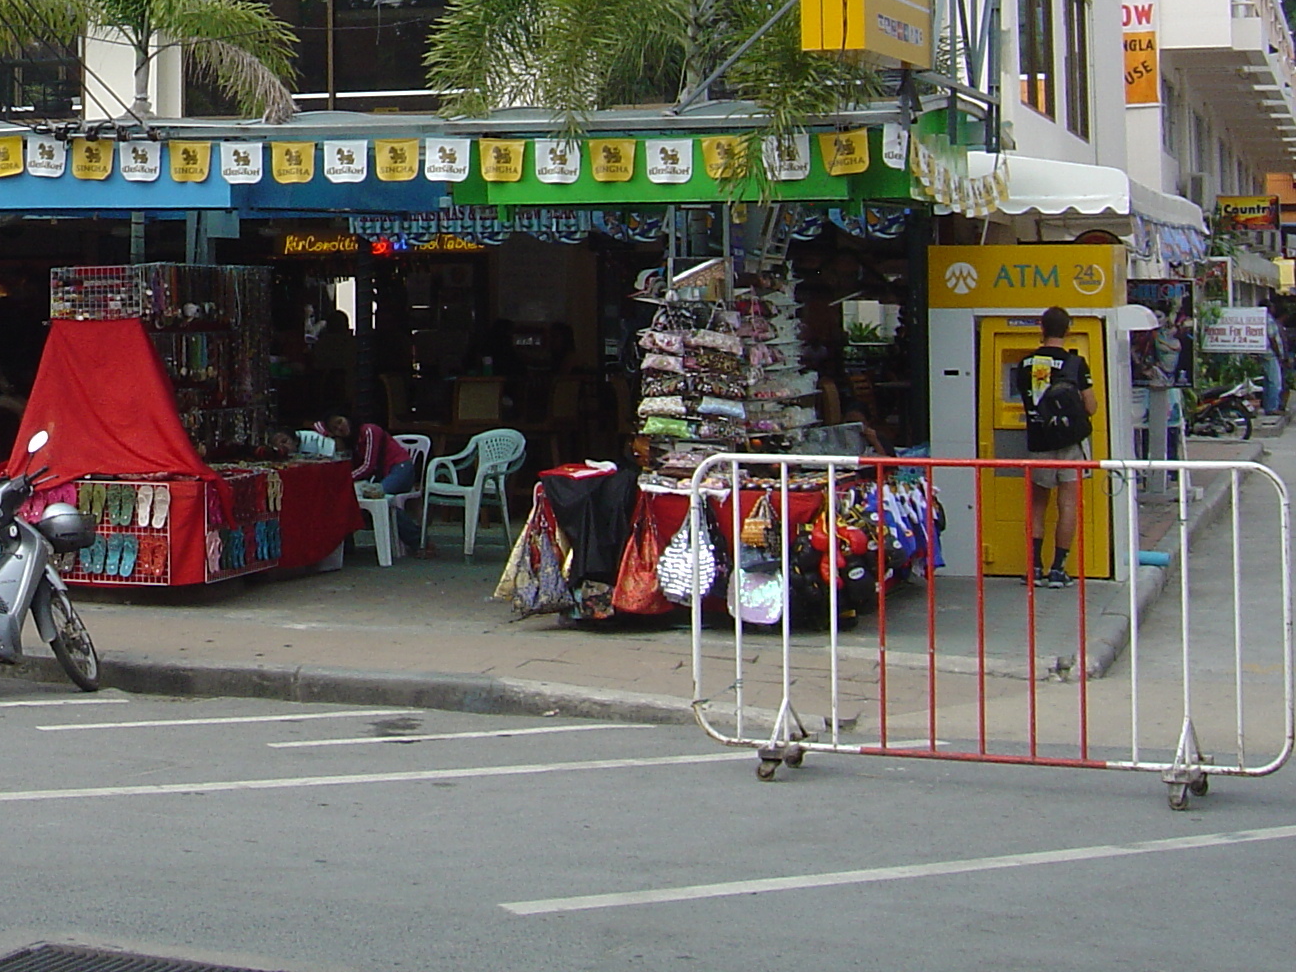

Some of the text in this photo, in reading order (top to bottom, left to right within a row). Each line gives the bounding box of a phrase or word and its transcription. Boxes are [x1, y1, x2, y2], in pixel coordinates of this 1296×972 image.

[276, 168, 311, 177] SINGHA
[379, 166, 415, 175] SINGHA
[484, 165, 519, 175] SINGHA
[594, 166, 629, 175] SINGHA
[993, 264, 1095, 288] ATM 24
